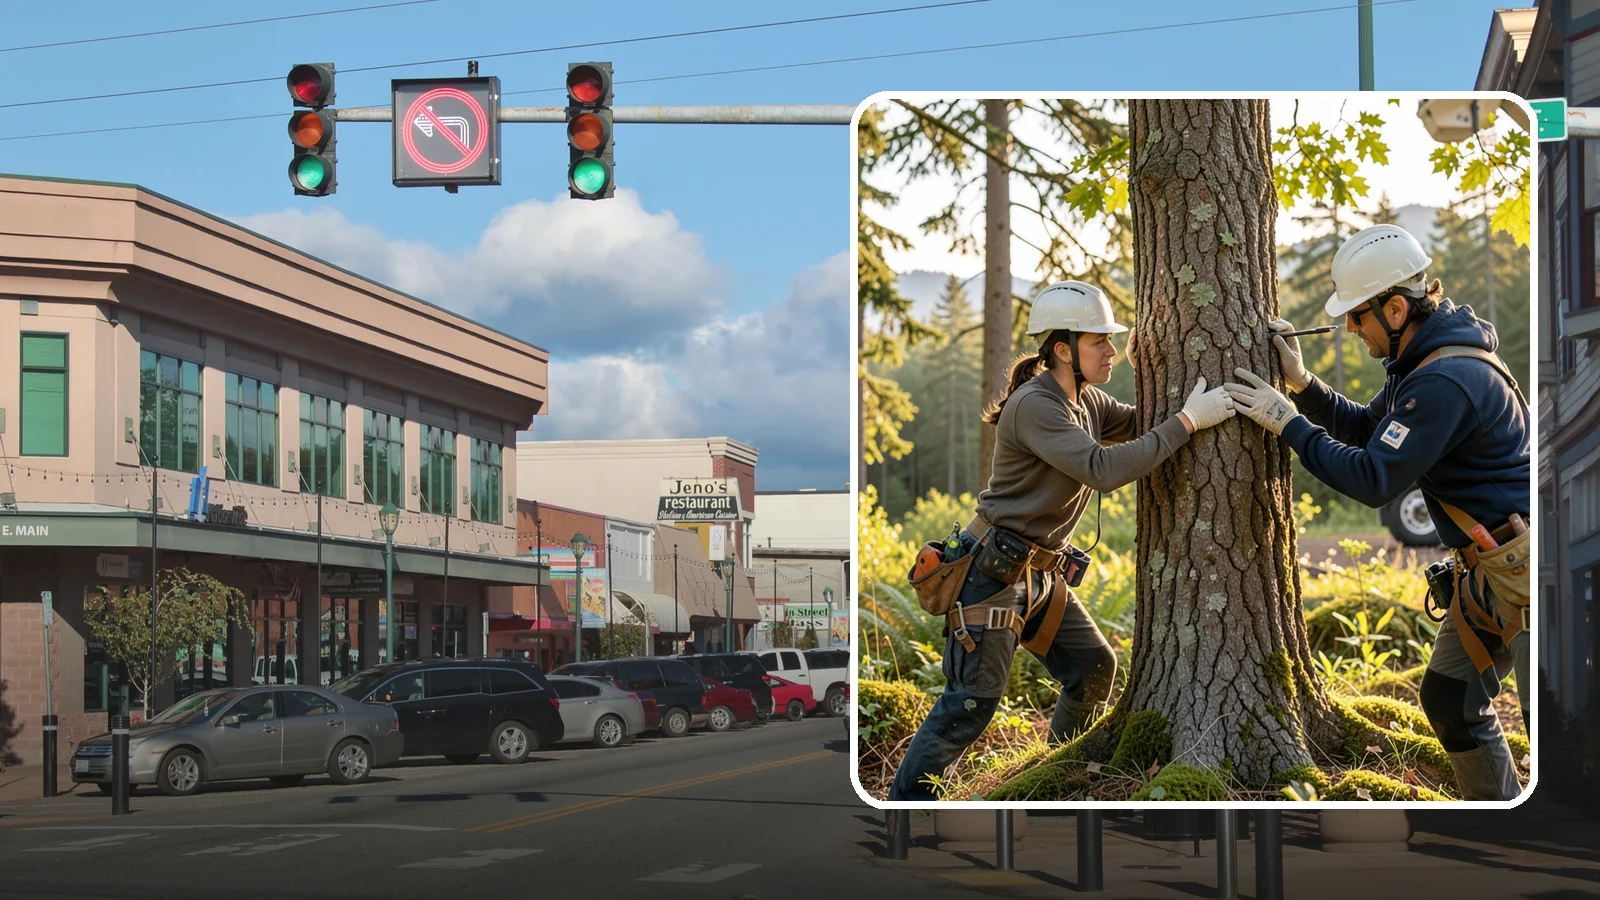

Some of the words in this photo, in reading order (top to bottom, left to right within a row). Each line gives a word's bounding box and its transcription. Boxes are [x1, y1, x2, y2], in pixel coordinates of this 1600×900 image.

[669, 480, 727, 494] Jeno's
[665, 496, 731, 509] restaurant
[686, 510, 715, 519] American
[715, 509, 737, 519] Cuisine
[2, 525, 13, 536] E.
[15, 525, 49, 536] MAIN
[797, 608, 828, 616] Street
